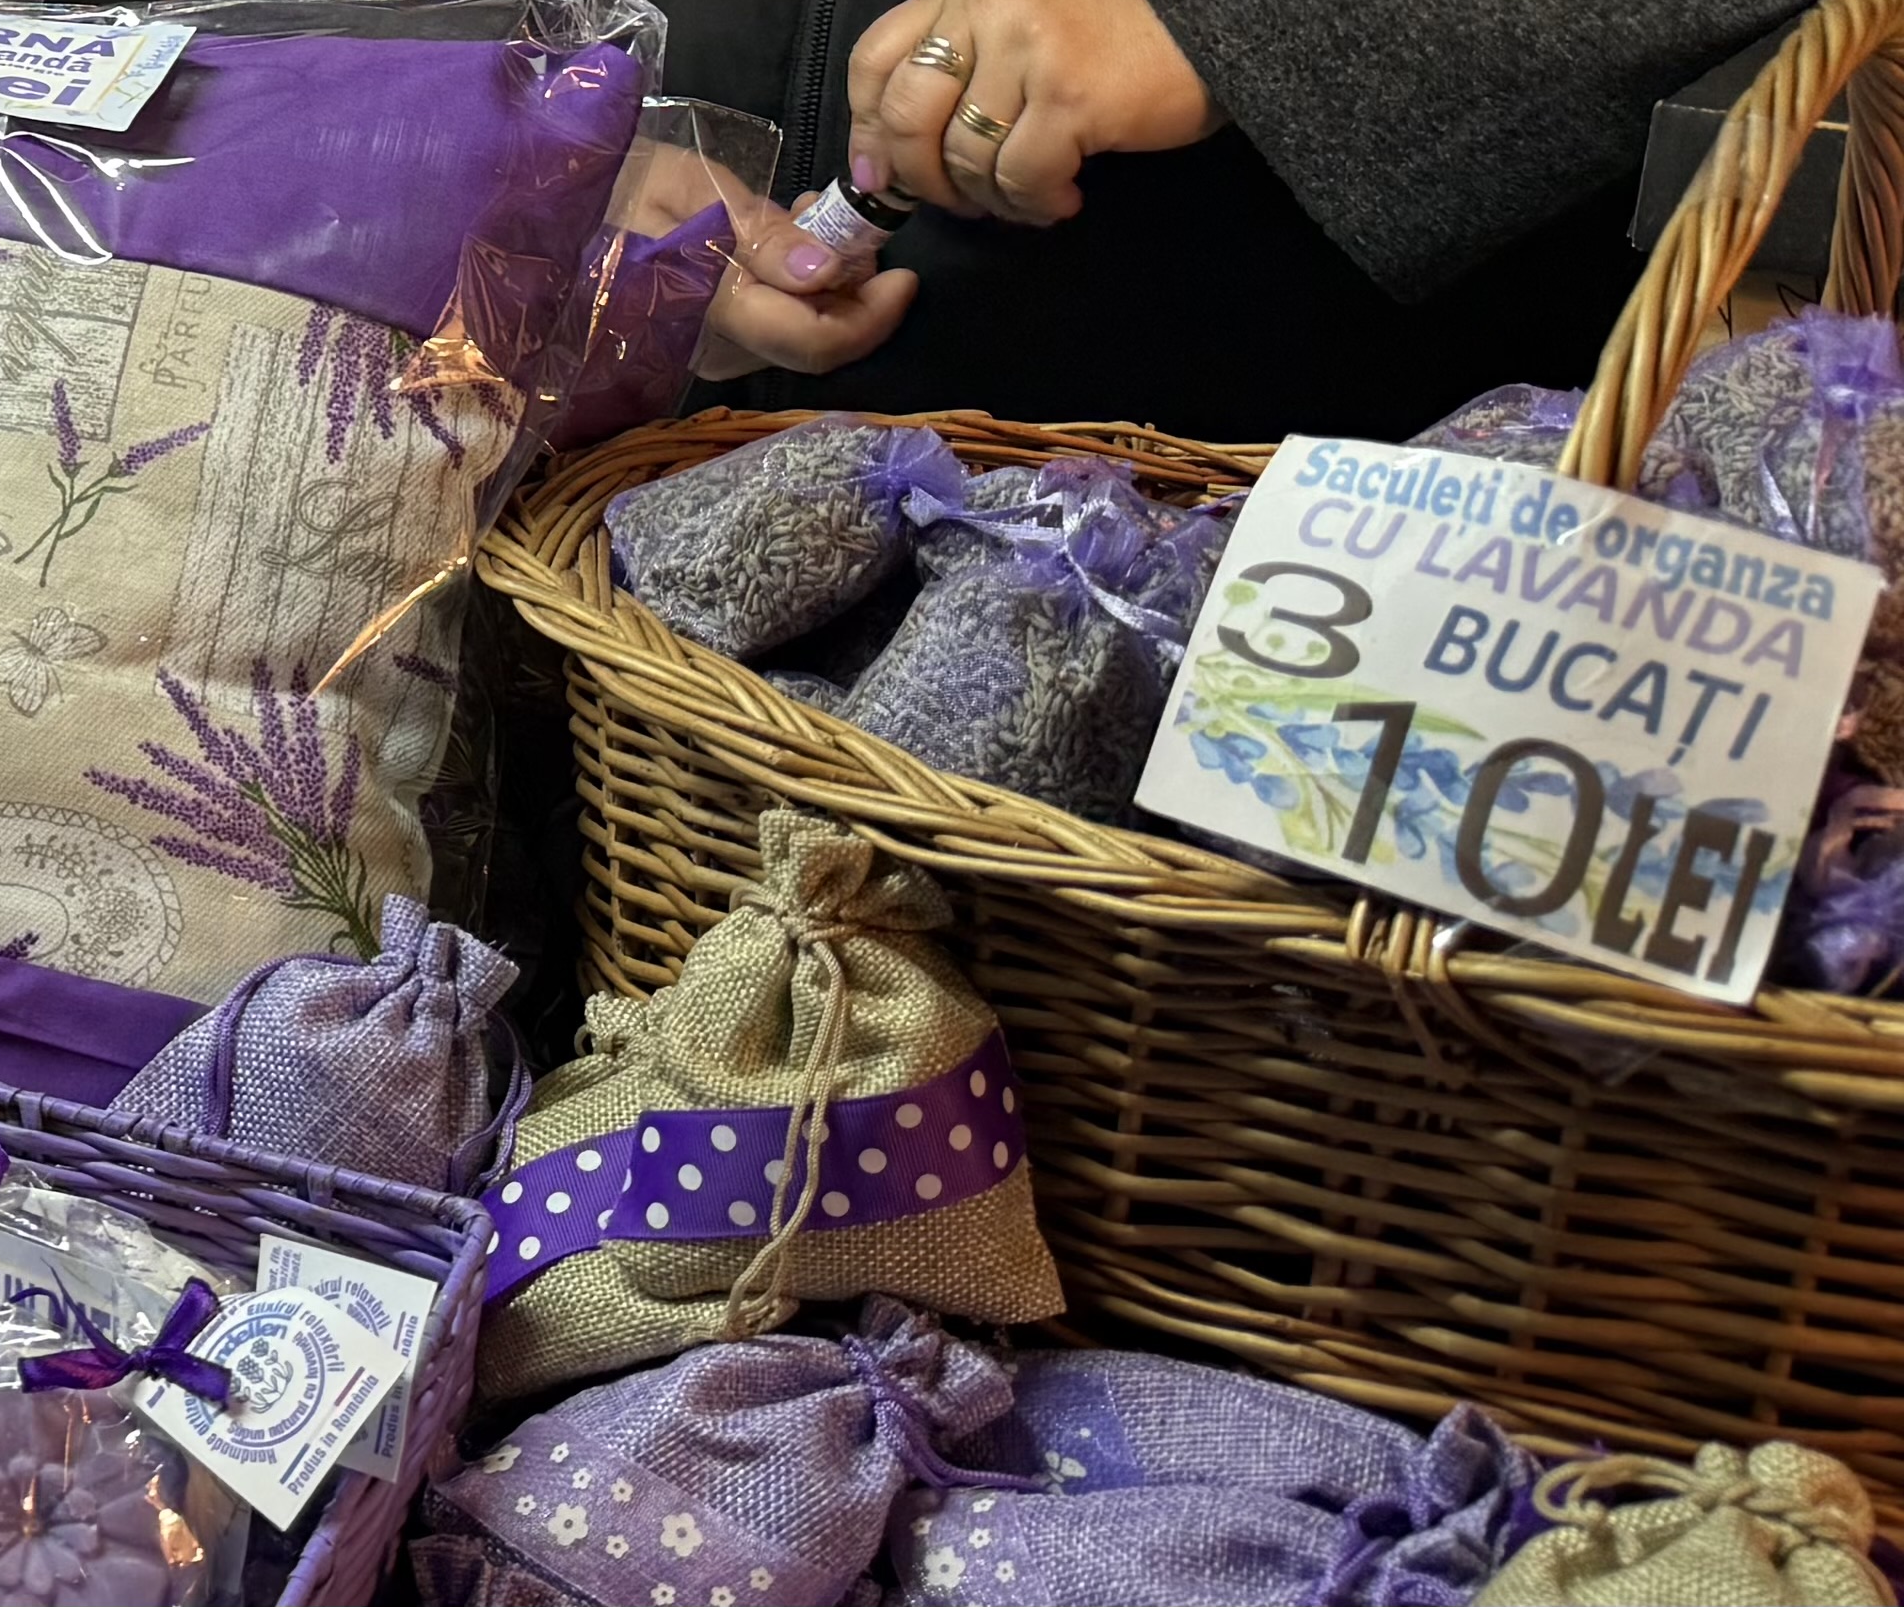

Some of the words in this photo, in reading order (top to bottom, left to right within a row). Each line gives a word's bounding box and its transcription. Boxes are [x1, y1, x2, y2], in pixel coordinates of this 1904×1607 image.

[1294, 438, 1506, 539] Saculeți
[1510, 473, 1579, 545] de
[1594, 512, 1837, 622] organza
[1297, 496, 1404, 562] CU
[1414, 523, 1807, 680] LAVANDA
[1215, 559, 1374, 680] 3
[1422, 602, 1772, 768] BUCAȚI
[245, 1300, 303, 1317] Elixirul
[299, 1308, 346, 1374] relaxării
[205, 1431, 278, 1465] Handmade
[268, 1398, 310, 1440] natural
[304, 1382, 319, 1402] cu
[286, 1446, 328, 1496] Produs
[330, 1373, 380, 1430] România
